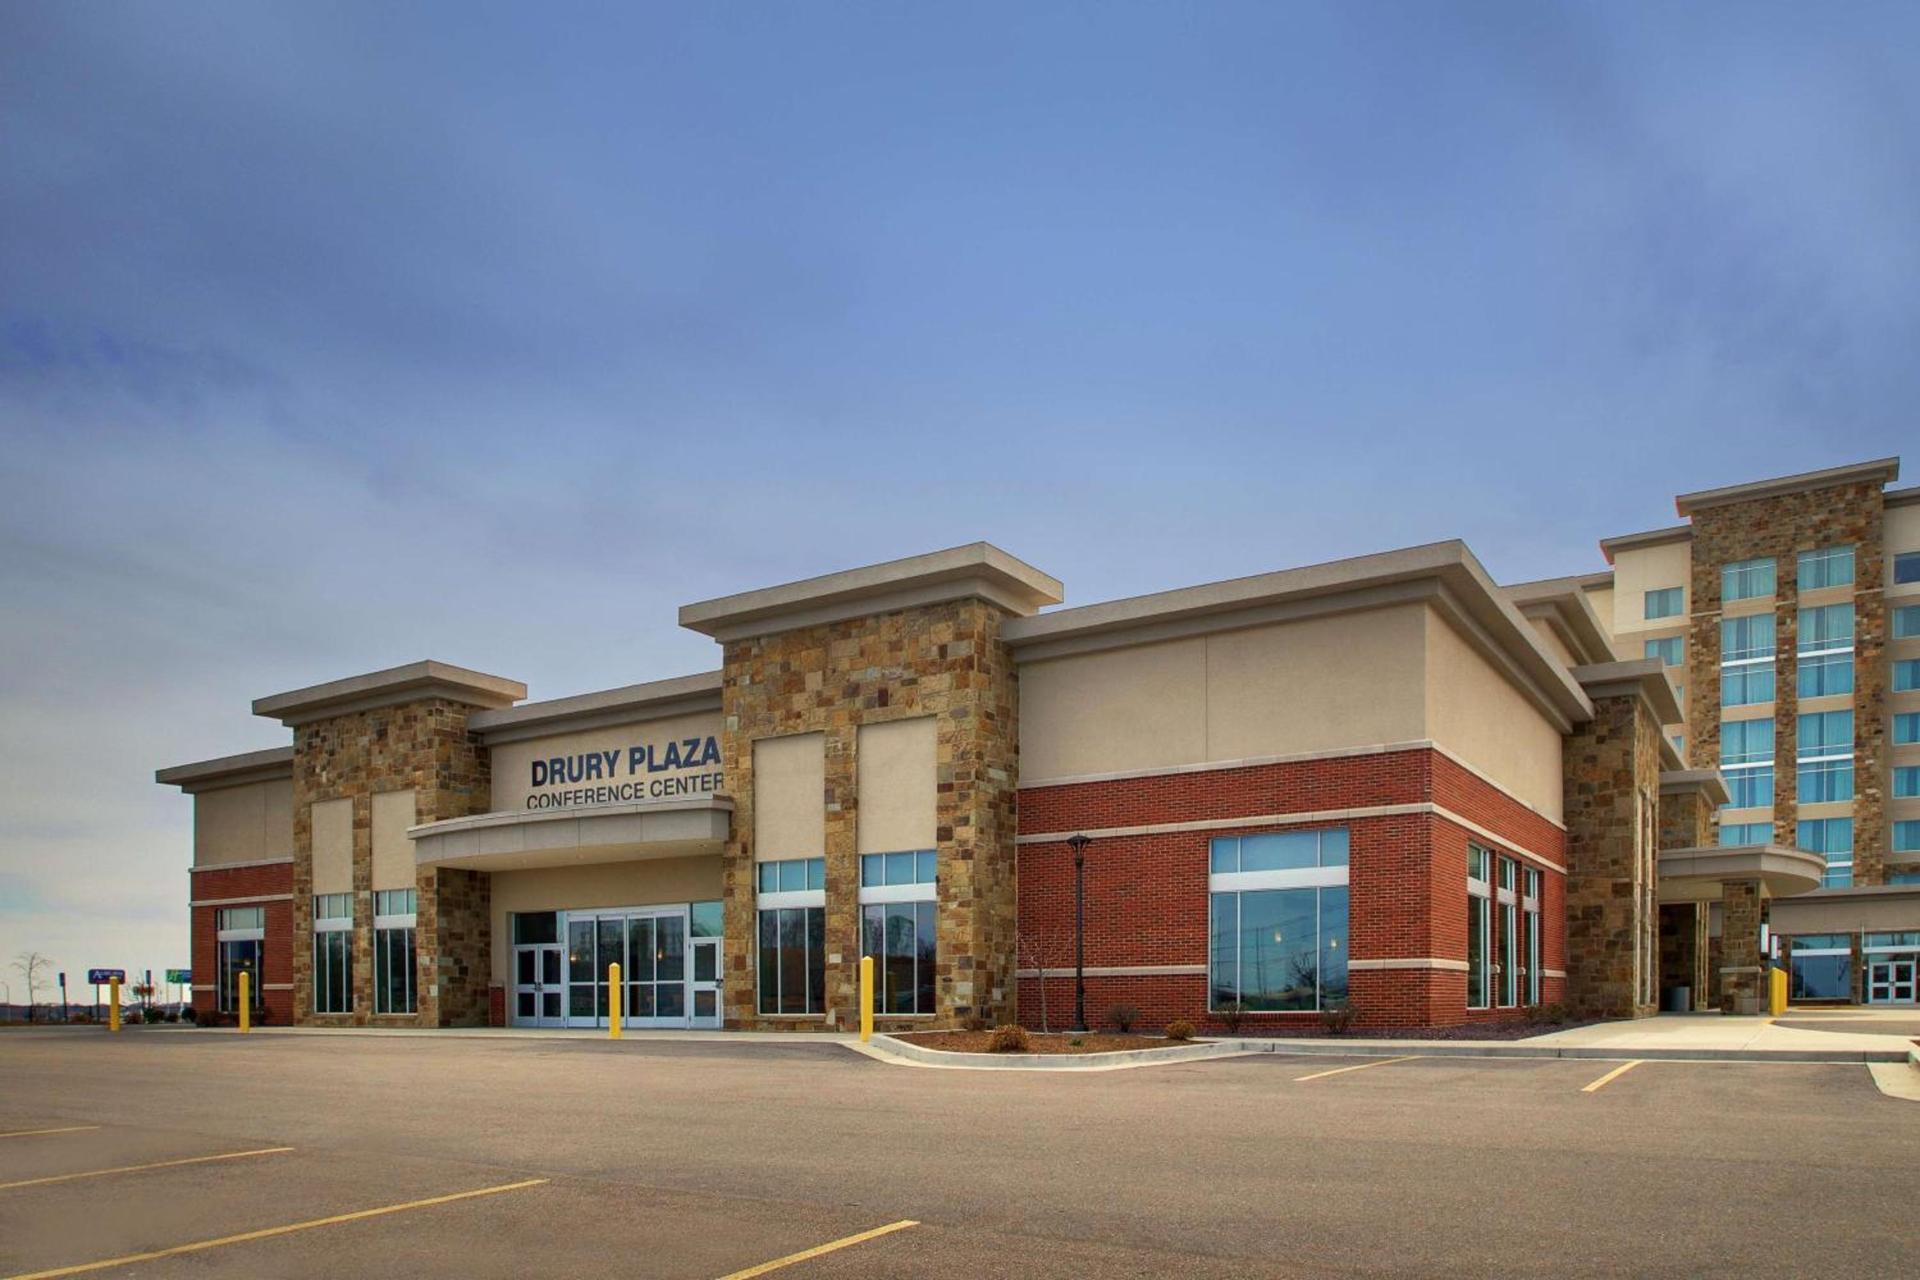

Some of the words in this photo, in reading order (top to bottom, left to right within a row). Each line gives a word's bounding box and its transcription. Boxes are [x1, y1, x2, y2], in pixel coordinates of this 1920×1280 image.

[532, 750, 621, 787] DRURY
[629, 736, 721, 775] PLAZA
[527, 782, 645, 809] CONFERENCE
[650, 772, 724, 797] CENTER
